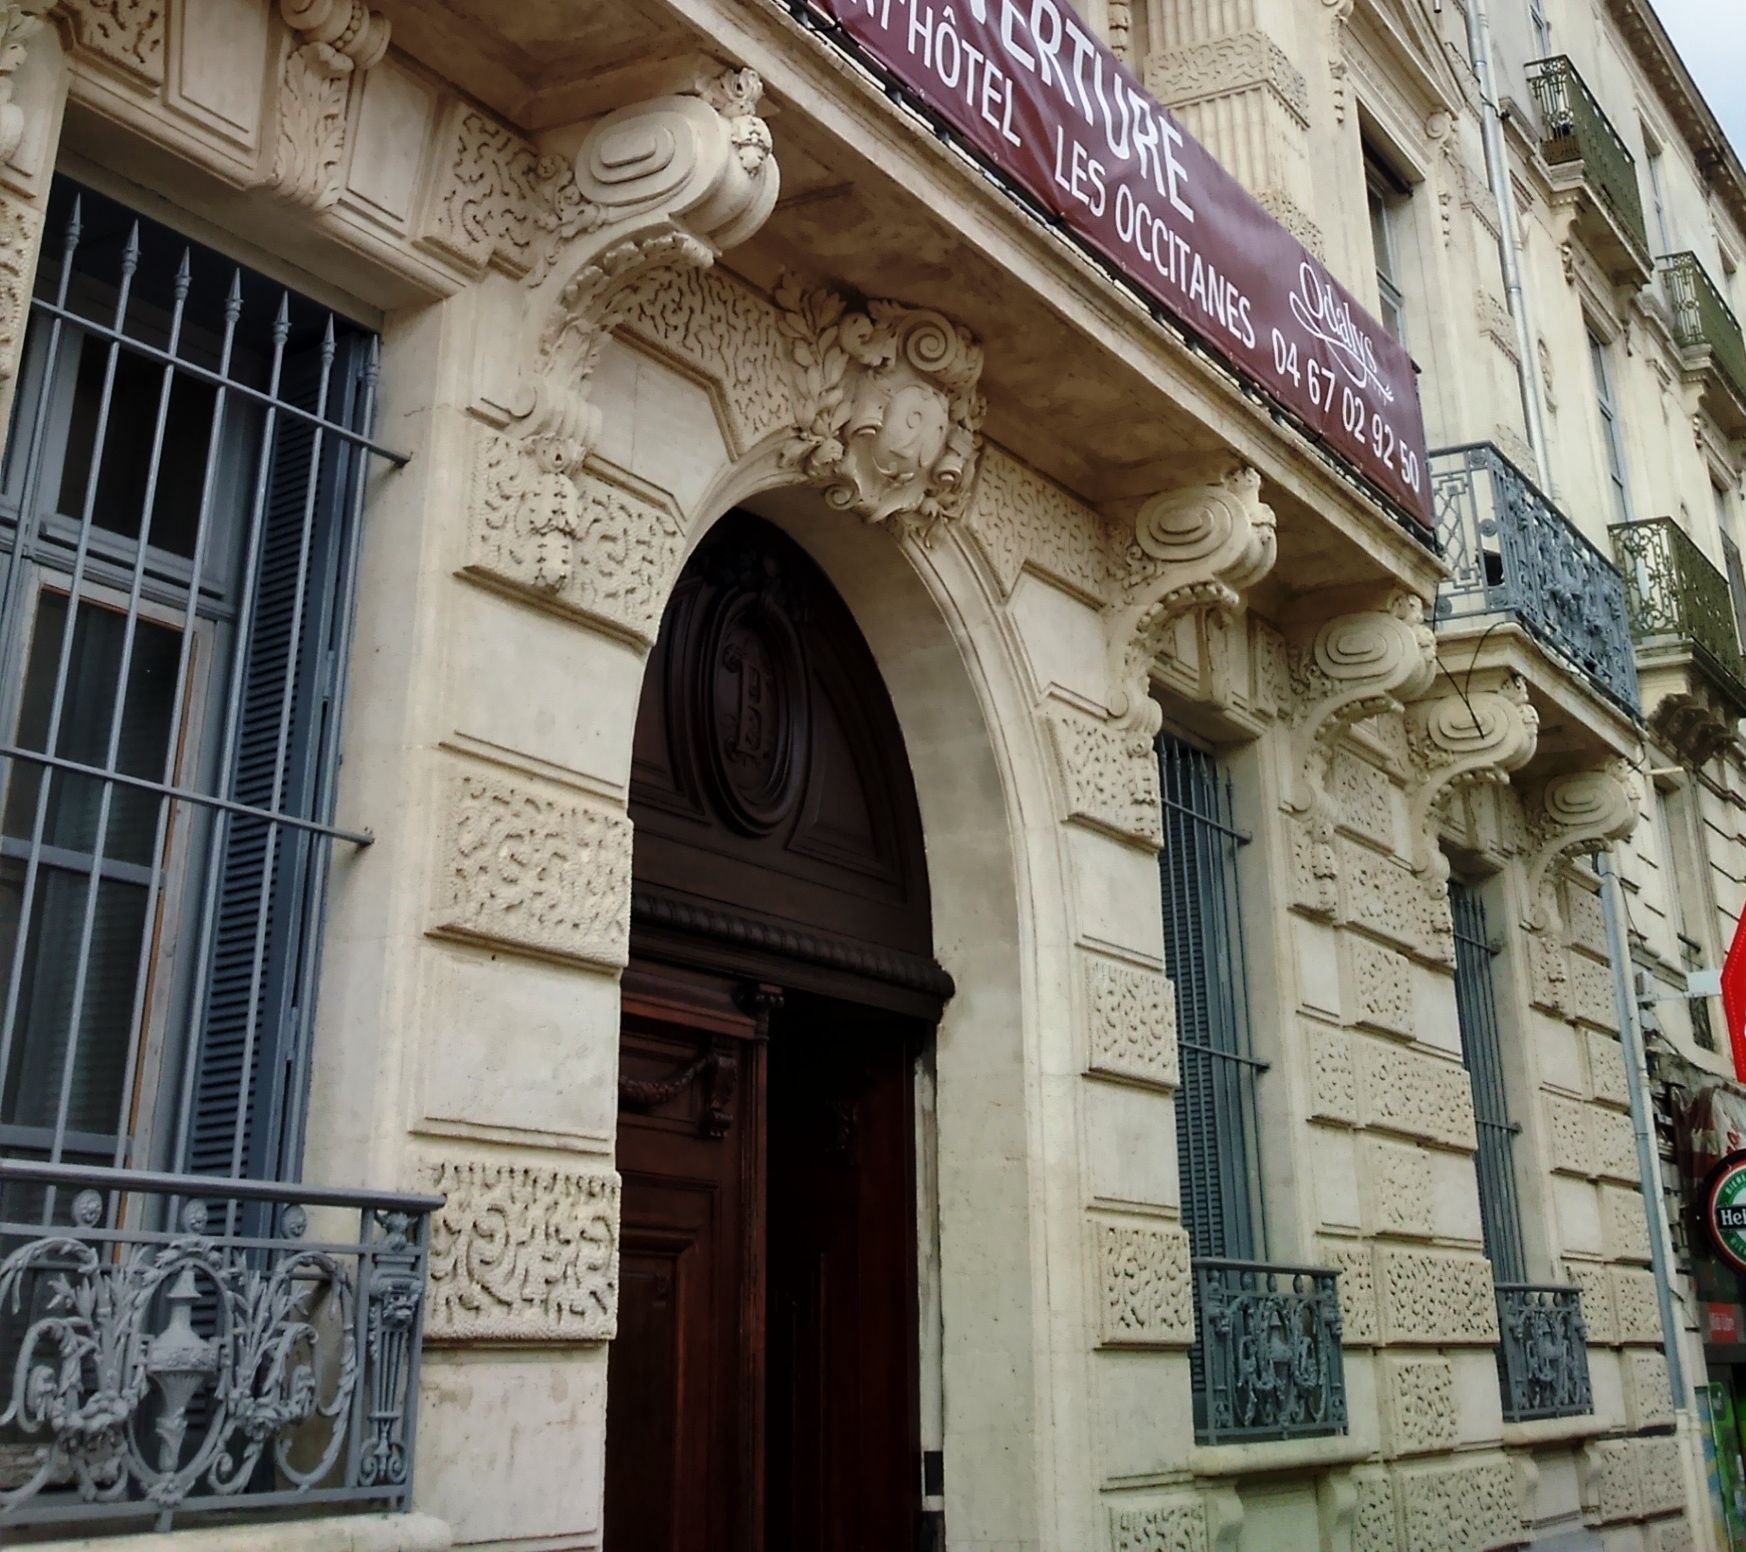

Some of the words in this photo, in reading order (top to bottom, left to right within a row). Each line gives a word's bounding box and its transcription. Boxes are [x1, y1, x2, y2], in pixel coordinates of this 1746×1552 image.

[1054, 124, 1106, 218] LES
[1115, 183, 1256, 350] OCCITANES
[1298, 261, 1378, 378] Odalys
[1271, 327, 1300, 387] 04
[1307, 358, 1335, 413] 67
[1342, 386, 1366, 444] 02
[1372, 413, 1394, 470] 92
[1399, 439, 1420, 494] 50
